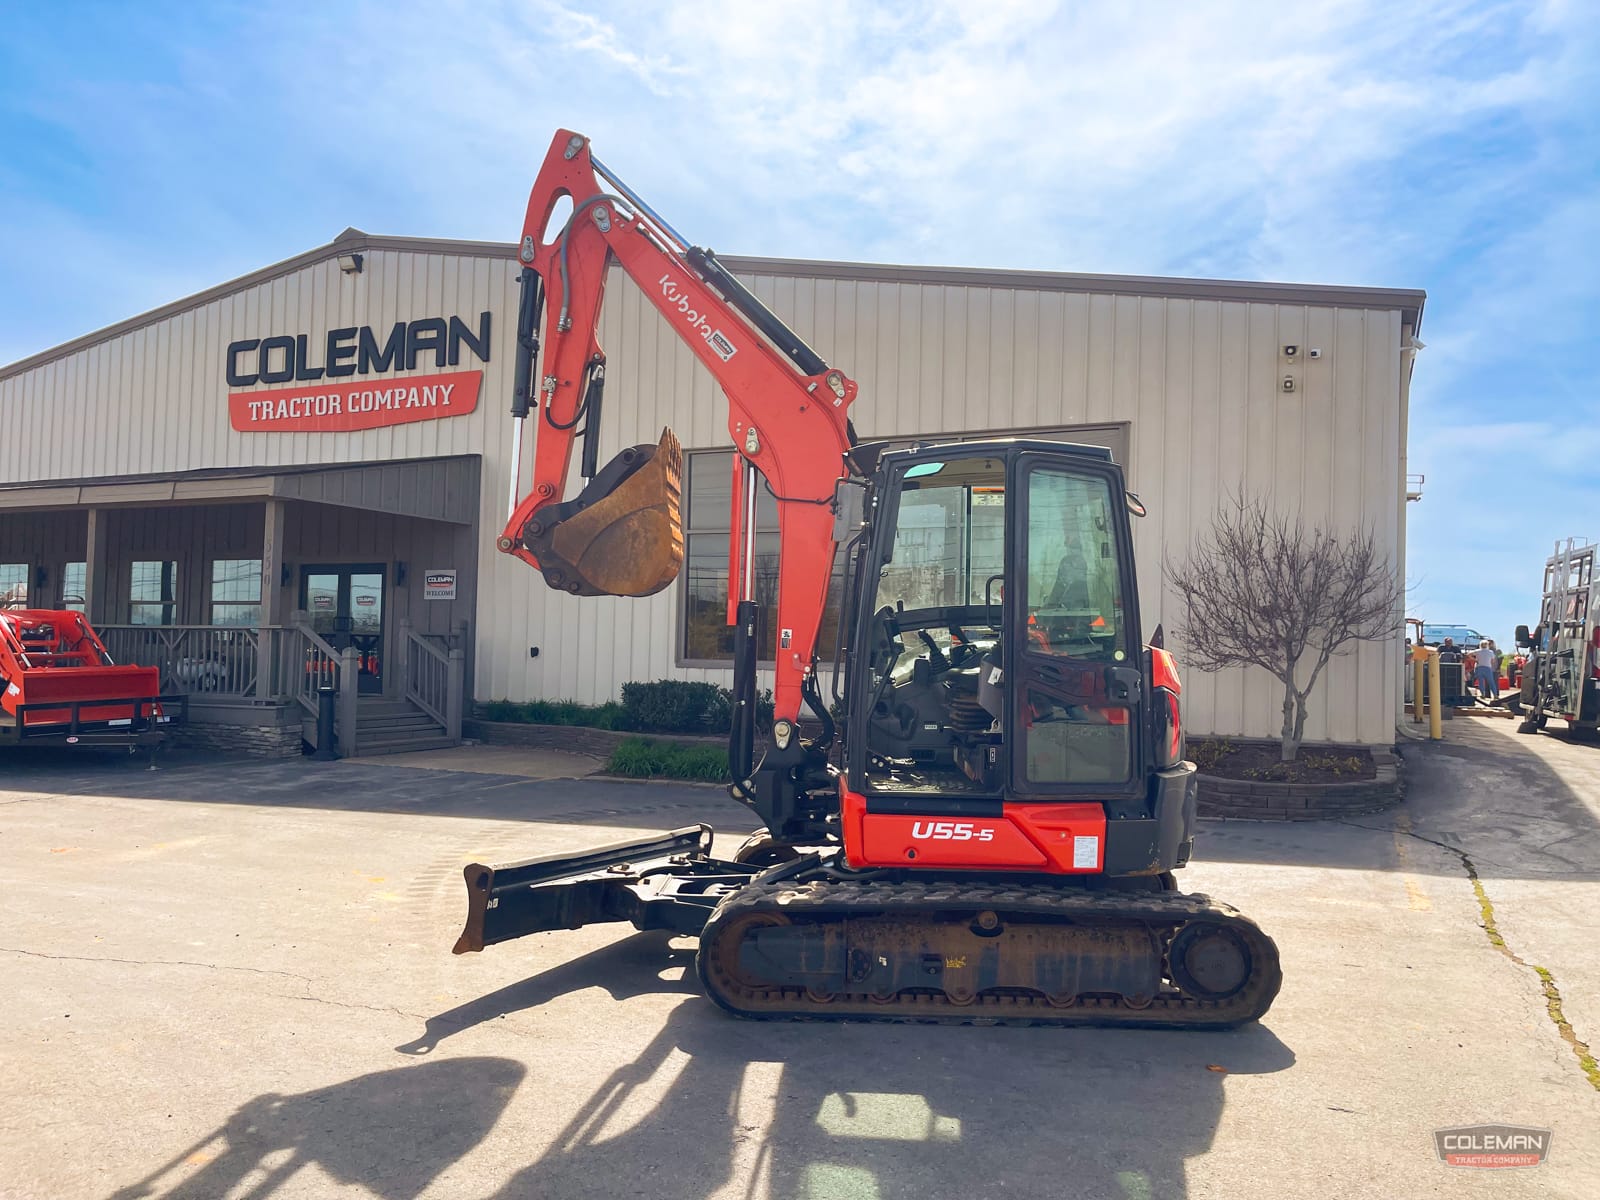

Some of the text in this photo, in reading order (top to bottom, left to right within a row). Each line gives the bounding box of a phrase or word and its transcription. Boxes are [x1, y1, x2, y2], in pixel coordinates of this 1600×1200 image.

[659, 274, 711, 339] Kubota
[226, 311, 491, 387] COLEMAN
[248, 384, 455, 421] TRACTOR COMPANY
[911, 821, 994, 841] U55-5
